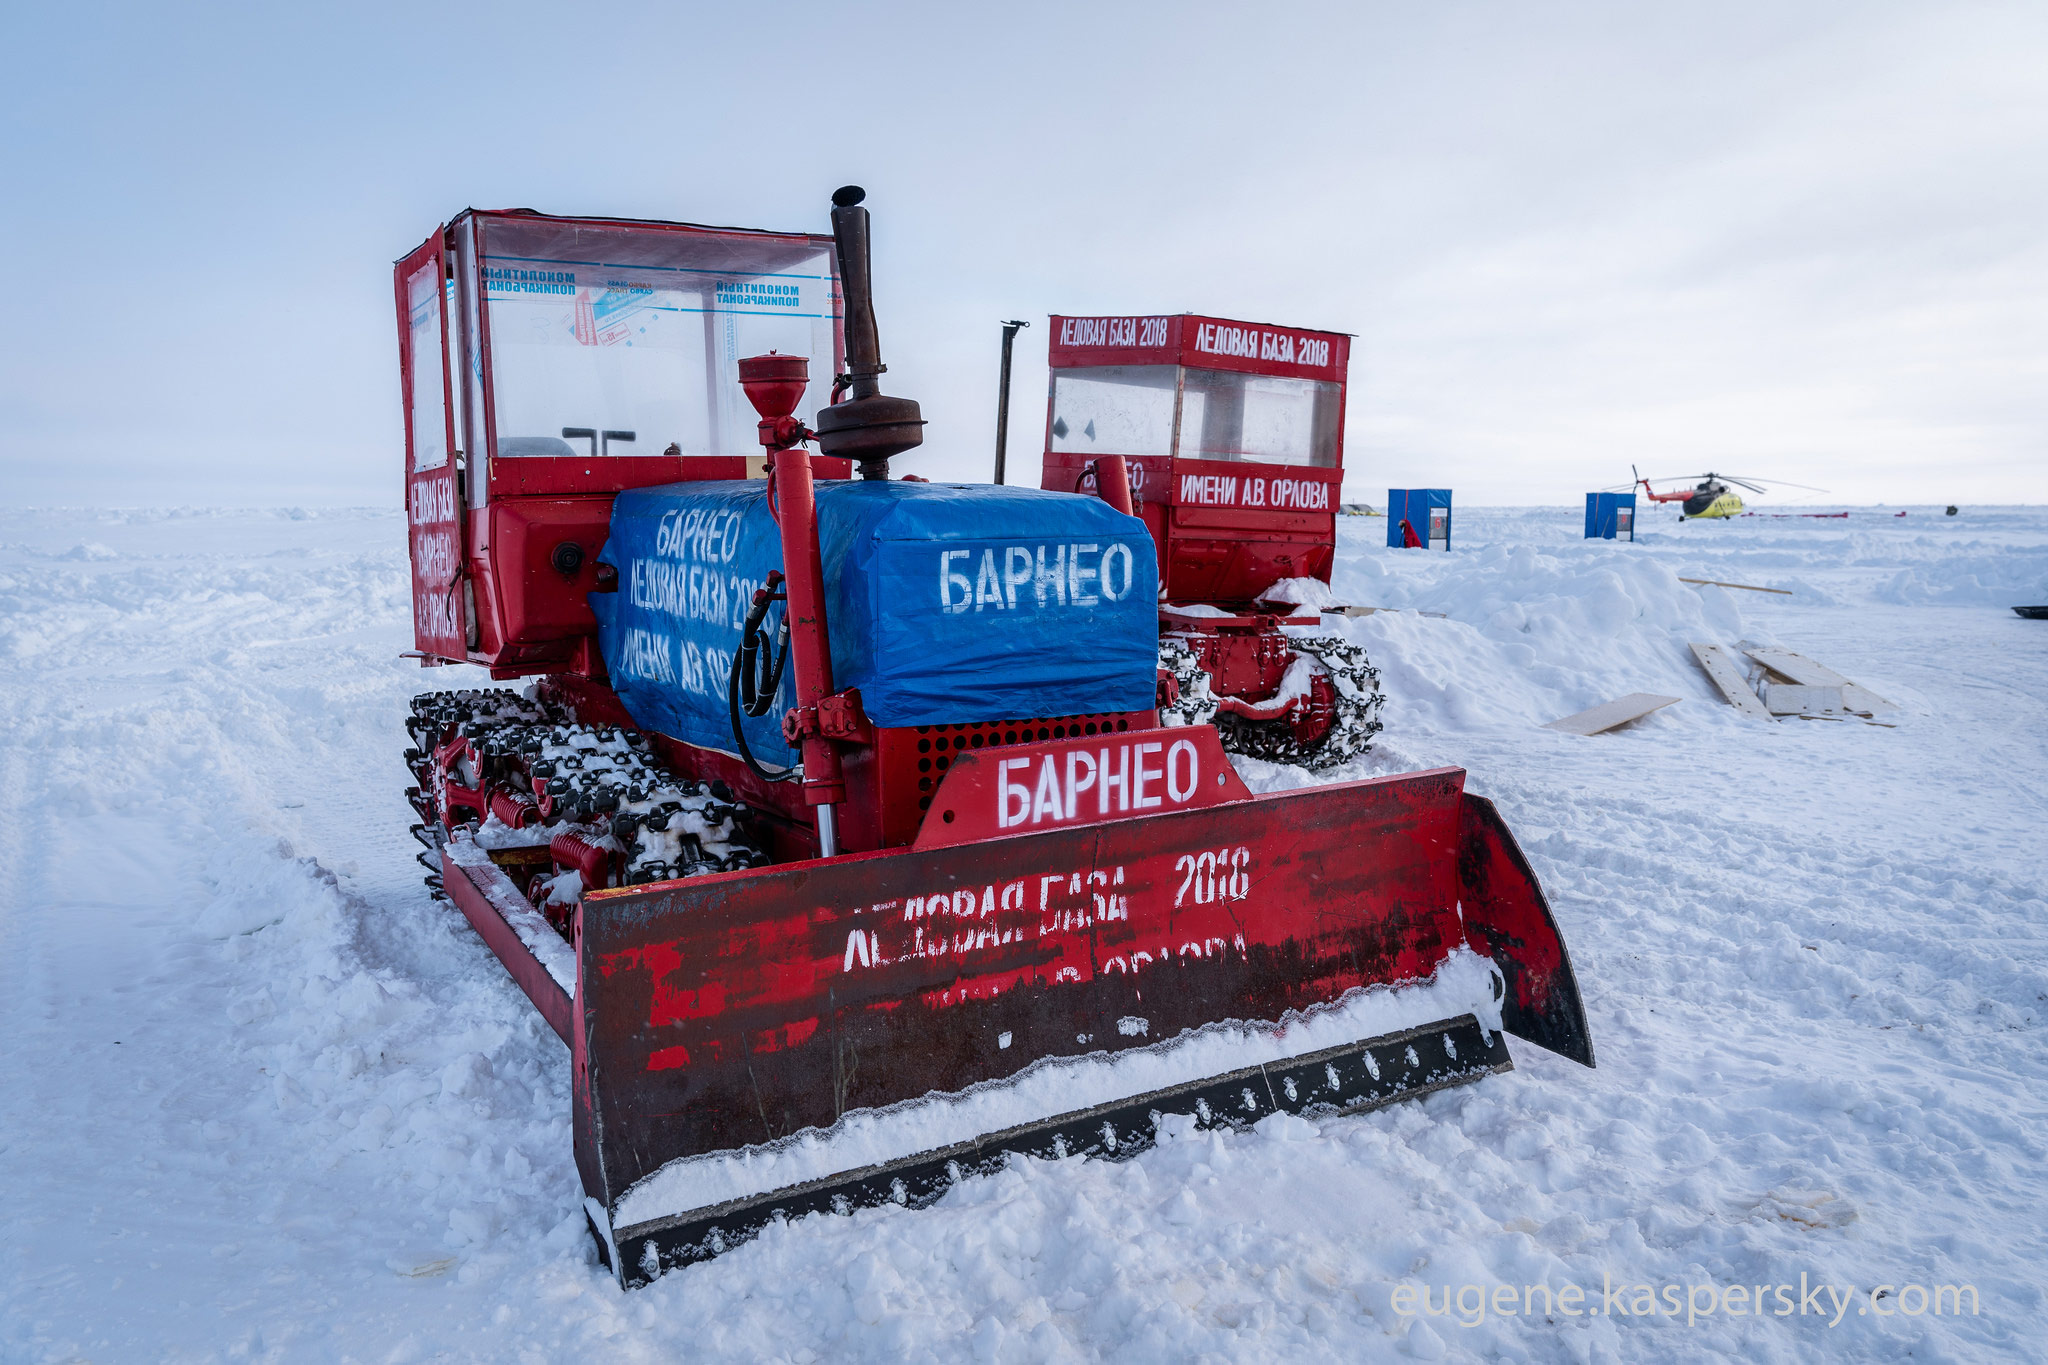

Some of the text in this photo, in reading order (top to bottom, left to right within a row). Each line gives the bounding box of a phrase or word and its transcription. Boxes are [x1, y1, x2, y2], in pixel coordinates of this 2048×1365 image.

[1060, 318, 1168, 347] ЛЕДОВАЯ БАЗА 2018
[1195, 322, 1329, 367] ЛЕДОВАЯ БАЗА 2018
[411, 476, 455, 526] ЛЕДОВАЯ БАЗА
[1181, 474, 1236, 504] ИМЕНИ
[1271, 479, 1328, 509] ОРЛОВА
[417, 532, 452, 578] БАРНЕО
[656, 508, 742, 564] БАРНЕО
[631, 558, 687, 618] ЛЕДОВАЯ
[690, 564, 729, 628] БАЗА
[940, 543, 1133, 614] БАРНЕО
[998, 739, 1199, 828] БАРНЕО
[1174, 846, 1250, 909] 2018
